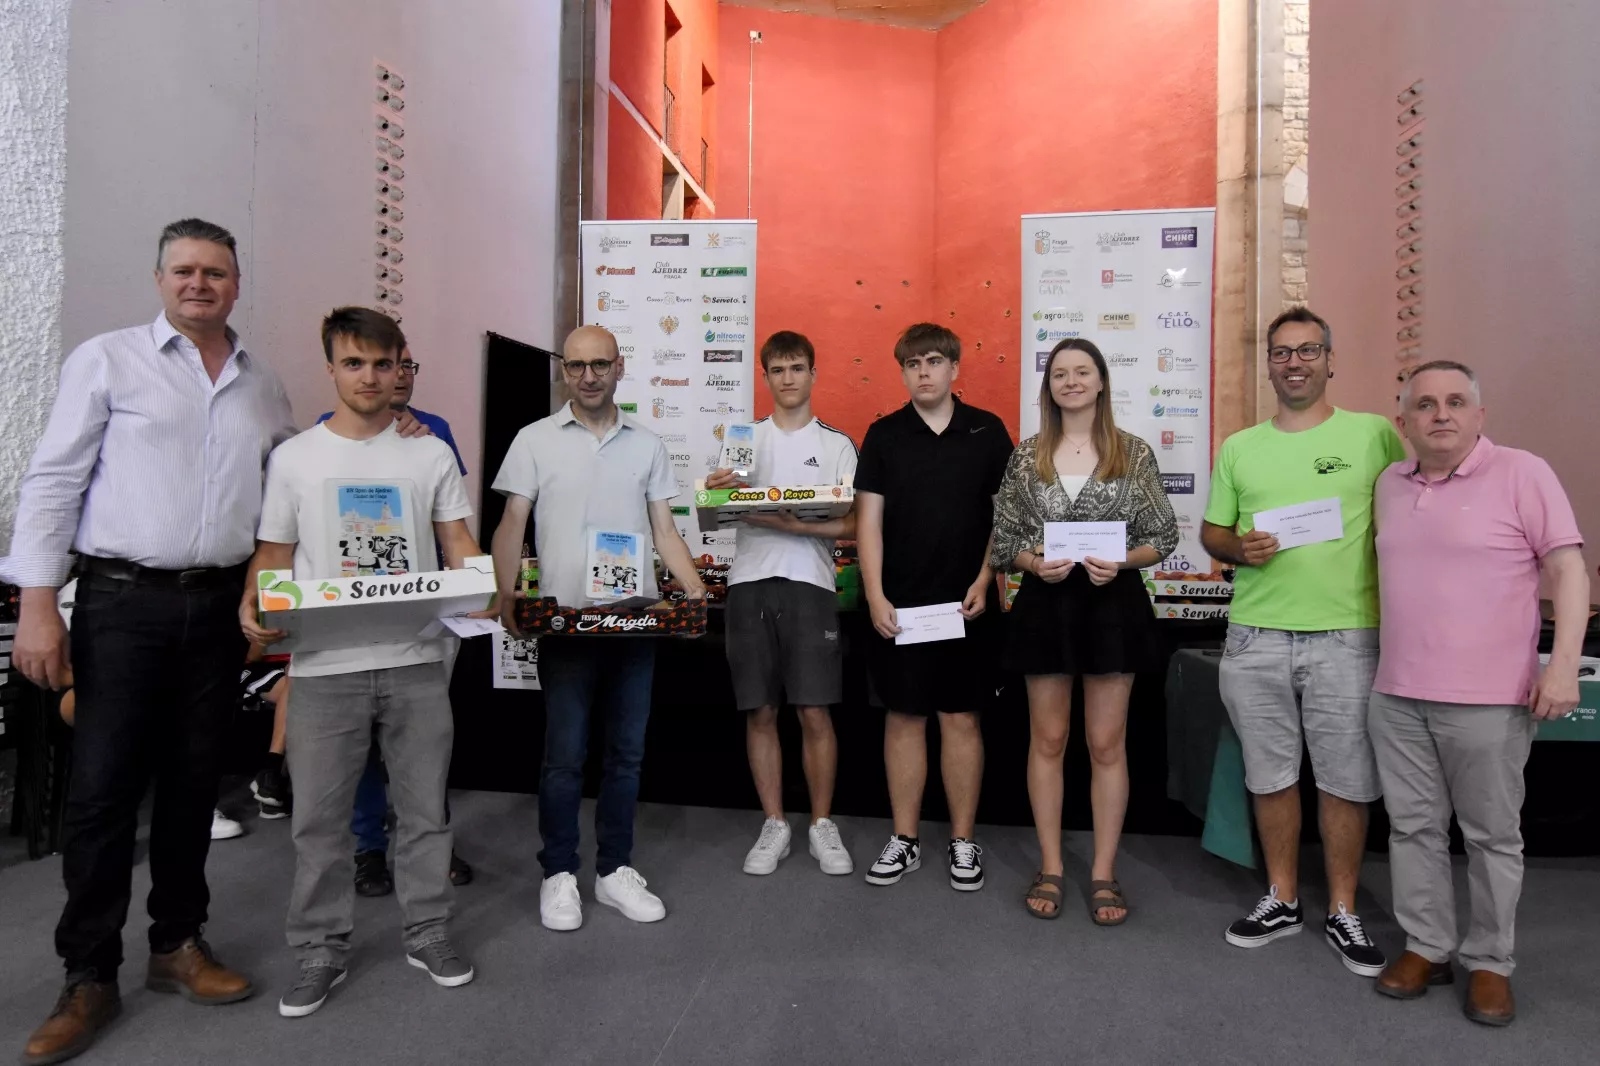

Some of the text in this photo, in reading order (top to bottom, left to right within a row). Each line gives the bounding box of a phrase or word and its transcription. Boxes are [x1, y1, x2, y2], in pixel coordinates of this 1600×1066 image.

[729, 491, 765, 501] Casas
[350, 577, 441, 599] Serveto
[600, 614, 658, 630] Magda
